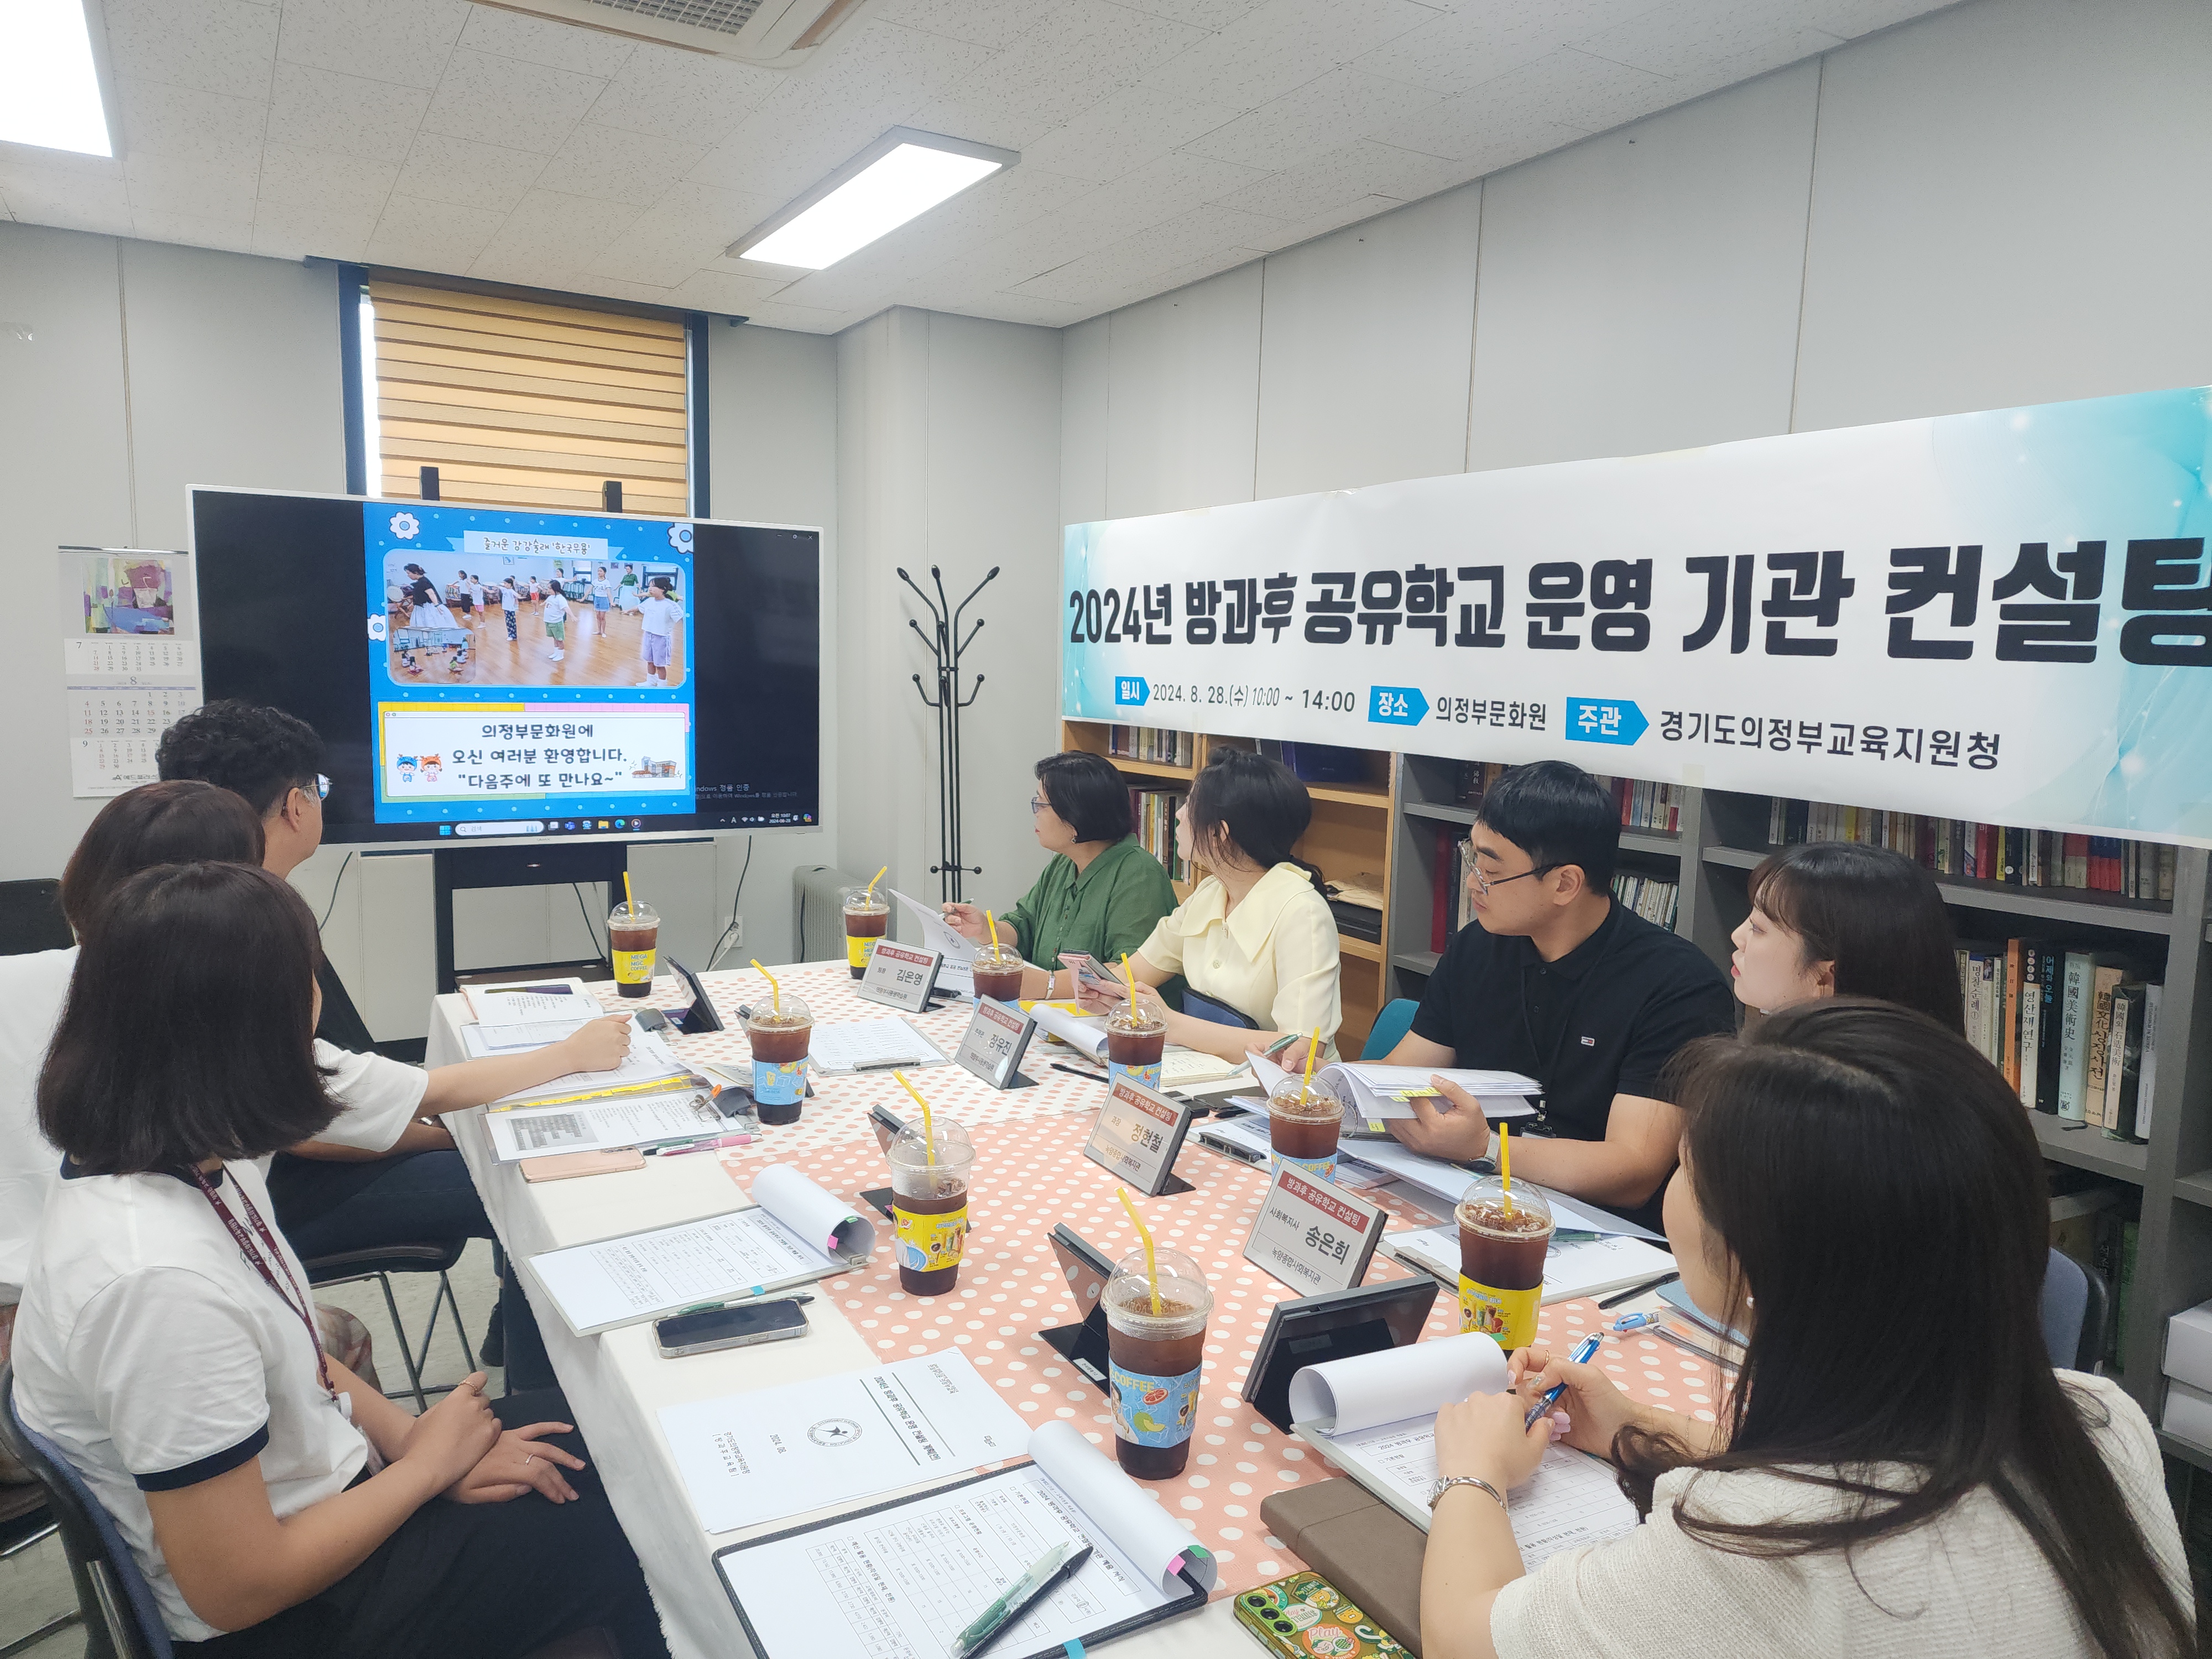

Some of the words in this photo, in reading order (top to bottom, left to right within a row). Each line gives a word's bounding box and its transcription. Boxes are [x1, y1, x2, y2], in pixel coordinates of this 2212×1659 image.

[483, 537, 509, 551] 즐거운
[513, 540, 550, 554] 강강술래
[1070, 583, 1172, 645] 2024년
[1186, 572, 1298, 645] 방과후
[1304, 564, 1505, 648] 공유학교
[1526, 559, 1653, 652] 운영
[1682, 551, 1855, 657] 기관
[130, 676, 137, 685] 8
[1120, 680, 1140, 700] 일시
[1153, 684, 1186, 702] 2024.
[1190, 685, 1203, 703] 8.
[1208, 684, 1248, 708] 28.(수)
[1252, 687, 1280, 707] 10:00
[1302, 689, 1355, 712] 14:00
[1379, 692, 1408, 717] 장소
[1436, 696, 1547, 731] 의정부문화원
[1578, 705, 1622, 736] 주관
[481, 723, 594, 740] 의정부문화원에
[1660, 711, 2000, 770] 경기도의정부교육지원청
[452, 749, 483, 765] 오신
[490, 748, 537, 764] 여러분
[544, 748, 627, 764] 환영합니다.
[458, 773, 530, 790] "다음주에
[538, 773, 551, 787] 또
[896, 969, 923, 985] 김은영
[2045, 956, 2054, 982] 어제의
[1970, 964, 1981, 1011] 명찰순례
[2064, 972, 2080, 1040] 韓國美術史
[2022, 990, 2036, 1052] 영산재연구
[989, 1034, 1012, 1056] 장유진
[1119, 1087, 1135, 1102] 방과후
[1134, 1095, 1156, 1113] 공유학교
[1155, 1107, 1172, 1121] 컨설팅
[1110, 1115, 1122, 1127] 과장
[1131, 1123, 1164, 1154] 정현철
[1105, 1145, 1141, 1172] 녹양종합사회복지관
[1286, 1177, 1308, 1196] 방과후
[1308, 1189, 1337, 1213] 공유학교
[1337, 1204, 1361, 1227] 컨설팅
[1270, 1206, 1300, 1231] 사회복지사
[1305, 1225, 1350, 1265] 송은희
[1272, 1246, 1322, 1286] 녹양종합사회복지관
[1114, 1371, 1155, 1393] COFFEE
[874, 1376, 890, 1389] 2024년
[884, 1390, 898, 1402] 방과후
[893, 1403, 911, 1420] 공유학교
[905, 1420, 918, 1429] 운영
[912, 1430, 928, 1443] 컨설팅
[723, 1432, 750, 1474] 경기도의정부교육지원청
[1036, 1490, 1051, 1501] 2024
[1301, 1580, 1321, 1595] TENNIS
[1290, 1610, 1318, 1623] TENNIS
[1308, 1627, 1340, 1639] Play
